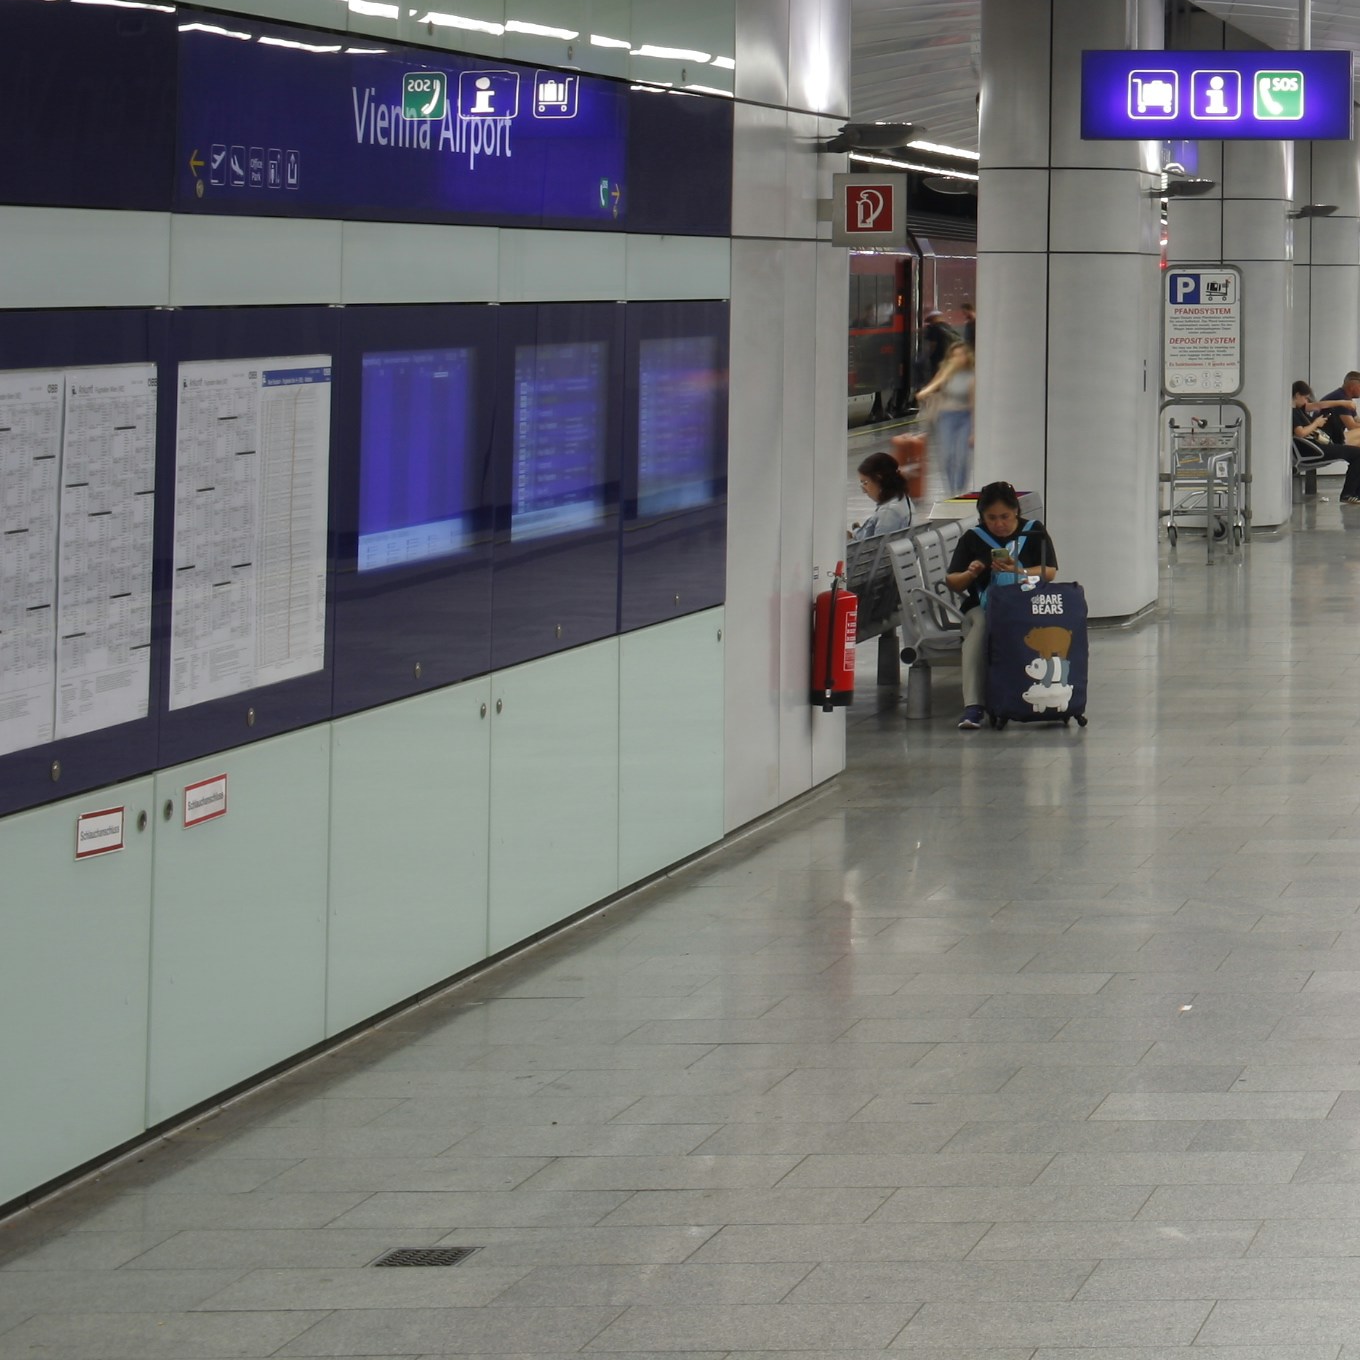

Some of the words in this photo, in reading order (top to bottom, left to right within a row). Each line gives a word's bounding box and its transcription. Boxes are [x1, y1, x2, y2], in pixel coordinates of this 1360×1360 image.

[1272, 77, 1299, 92] SOS
[353, 86, 431, 150] Vienna
[438, 98, 512, 171] Airport
[1176, 276, 1196, 303] P
[1174, 307, 1232, 315] PFANDSYSTEM
[1040, 594, 1063, 605] BARE
[1032, 604, 1064, 615] BEARS
